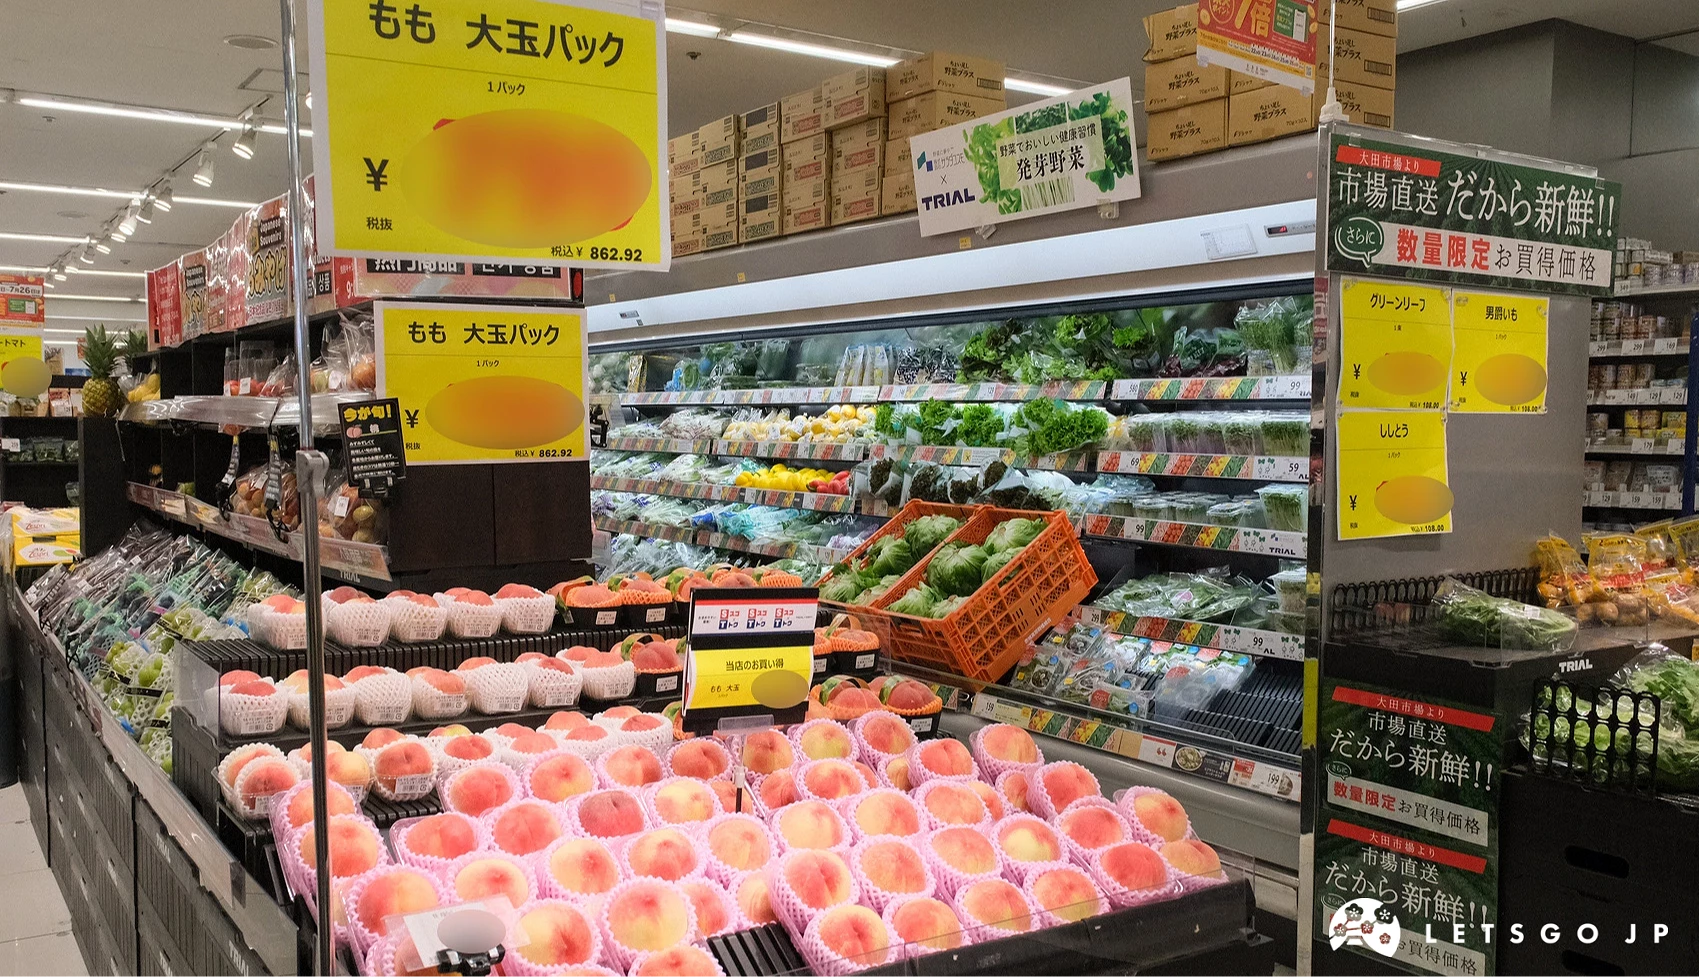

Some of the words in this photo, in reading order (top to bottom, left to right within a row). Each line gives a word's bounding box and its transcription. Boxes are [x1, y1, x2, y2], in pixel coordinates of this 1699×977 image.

[369, 0, 436, 43] もも
[465, 13, 624, 67] 大玉パック
[1165, 27, 1197, 41] 野菜プラス
[944, 67, 975, 79] 野菜プラス
[1168, 77, 1200, 91] 野菜プラス
[947, 106, 976, 118] 野菜プラス
[1253, 107, 1287, 122] 野菜プラス
[1000, 123, 1096, 157] 野菜でおいしい健康習慣
[1170, 127, 1201, 140] 野菜プラス
[1016, 146, 1085, 182] 発芽野菜
[1359, 150, 1421, 173] 大田市場より
[363, 157, 389, 192] ¥
[1337, 167, 1438, 216] 市場直送
[921, 188, 976, 211] TRIAL
[366, 217, 393, 231] 税抜
[1345, 226, 1375, 245] さらに
[590, 247, 642, 262] 862.92
[1370, 293, 1426, 312] グリーンリーフ
[1485, 306, 1518, 322] 男爵いも
[408, 321, 447, 344] もも
[463, 322, 560, 345] 大玉パック
[1353, 364, 1361, 380] ¥
[1460, 371, 1468, 386] ¥
[1291, 381, 1300, 390] 99
[1422, 401, 1440, 409] 108.00
[405, 409, 419, 428] ¥
[1380, 423, 1409, 439] ししとう
[405, 442, 421, 450] 税抜
[538, 449, 573, 458] 862.92
[1131, 457, 1139, 466] 69
[1289, 463, 1299, 472] 59
[1349, 495, 1357, 511] ¥
[1136, 525, 1145, 533] 99
[1269, 547, 1296, 556] TRIAL
[1253, 636, 1263, 647] 99
[726, 658, 784, 672] 当店のお買い得
[1559, 658, 1593, 673] TRIAL
[710, 685, 722, 693] もも
[726, 684, 740, 692] 大玉
[1376, 695, 1445, 720] 大田市場より
[1367, 711, 1447, 746] 市場直送
[1267, 772, 1280, 784] 199
[1369, 832, 1436, 859] 大田市場より
[1361, 846, 1440, 885] 市場直送
